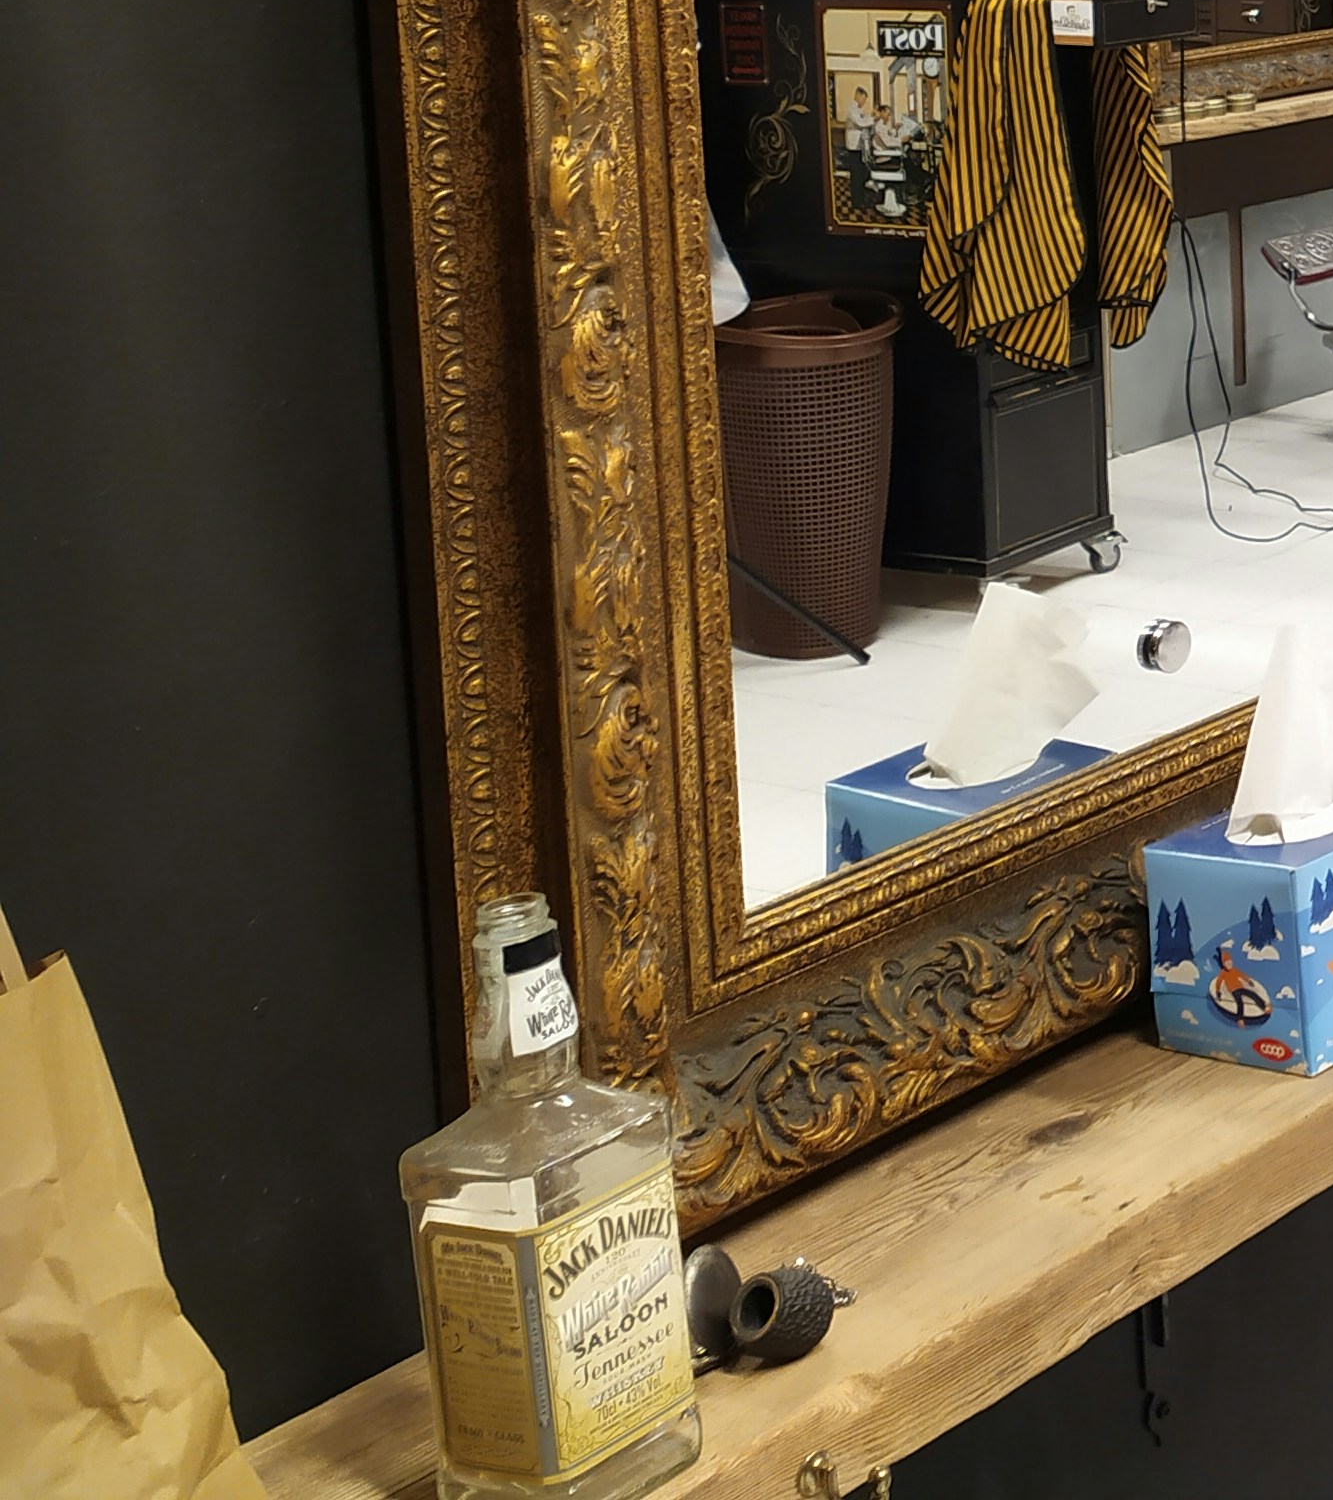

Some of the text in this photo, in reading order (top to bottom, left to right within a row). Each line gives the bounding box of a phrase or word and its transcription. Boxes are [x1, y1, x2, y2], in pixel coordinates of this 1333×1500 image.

[1259, 1042, 1286, 1058] coop
[543, 1200, 676, 1301] JACK DANIEL'S
[573, 1290, 669, 1362] SALOON
[573, 1322, 674, 1389] Tennessee
[594, 1374, 662, 1424] 70cl 43% Vol
